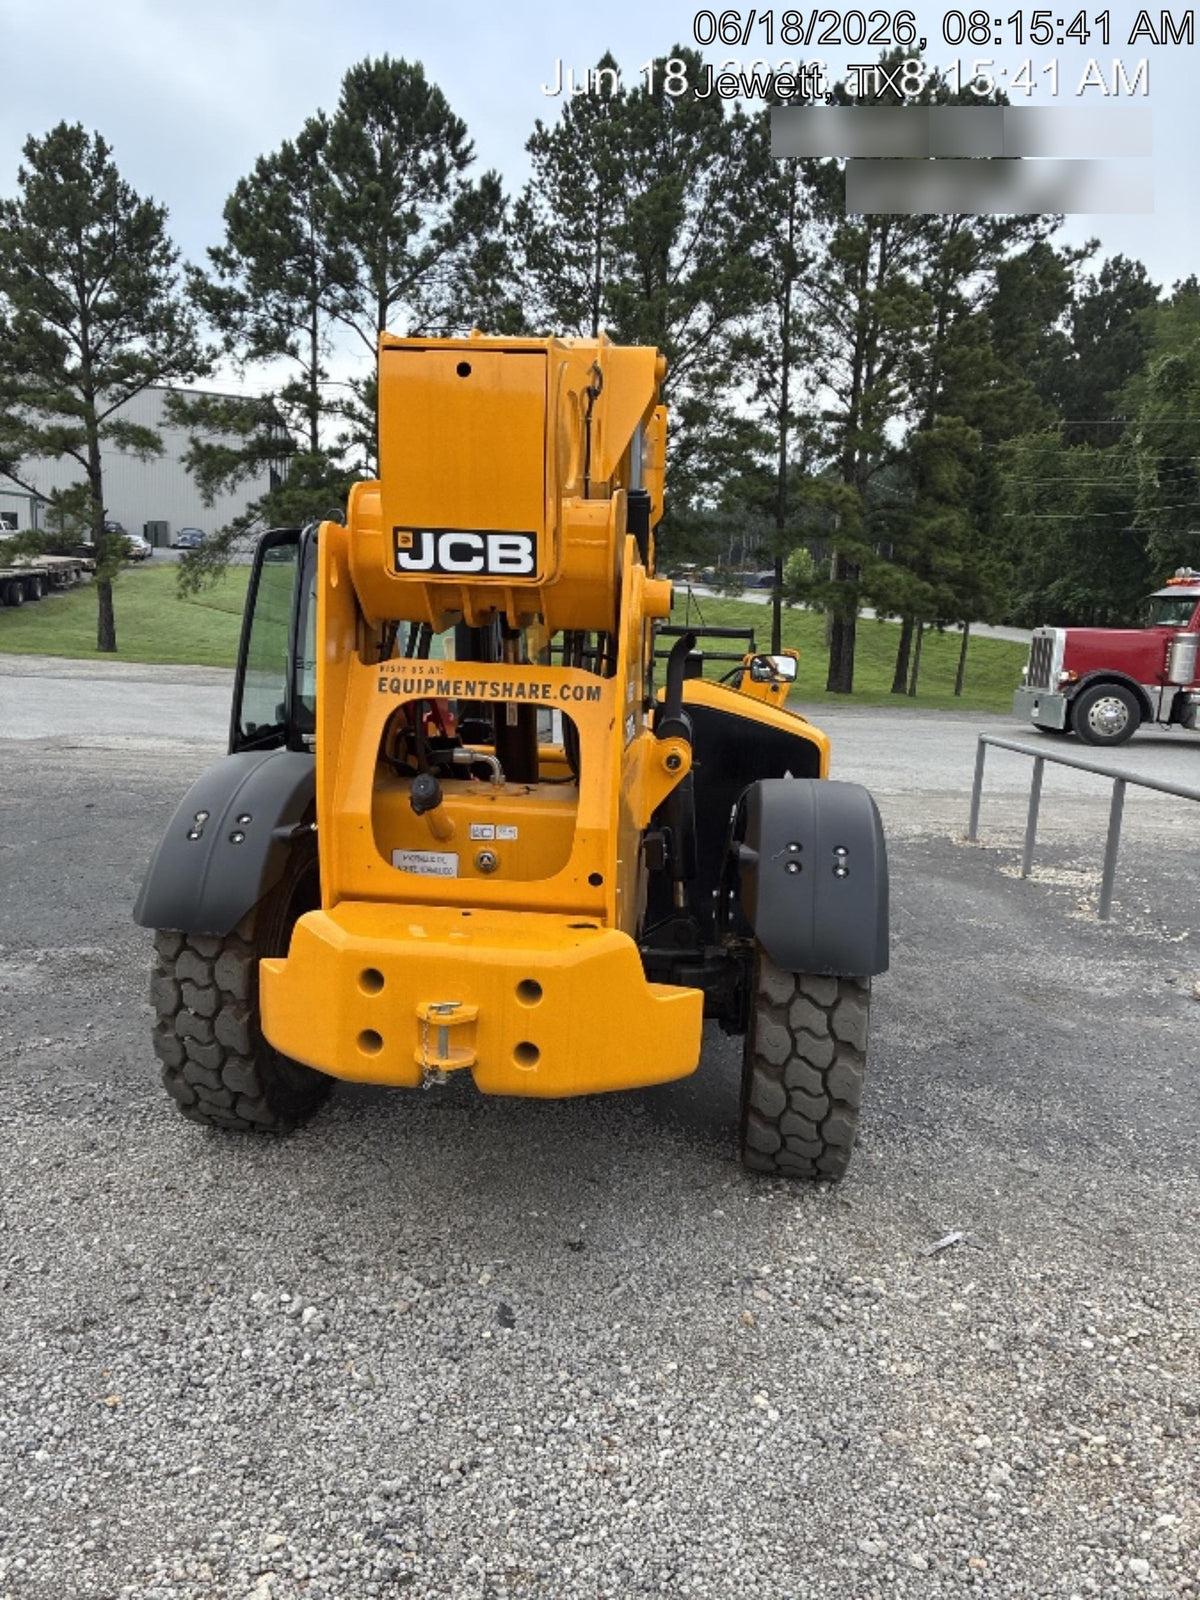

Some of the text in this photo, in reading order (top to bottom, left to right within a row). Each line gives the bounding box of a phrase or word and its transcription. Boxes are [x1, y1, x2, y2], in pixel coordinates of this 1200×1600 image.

[397, 532, 534, 574] JCB
[379, 664, 406, 673] VISIT
[411, 665, 424, 674] US
[378, 677, 602, 702] EQUIPMENTSHARE.COM
